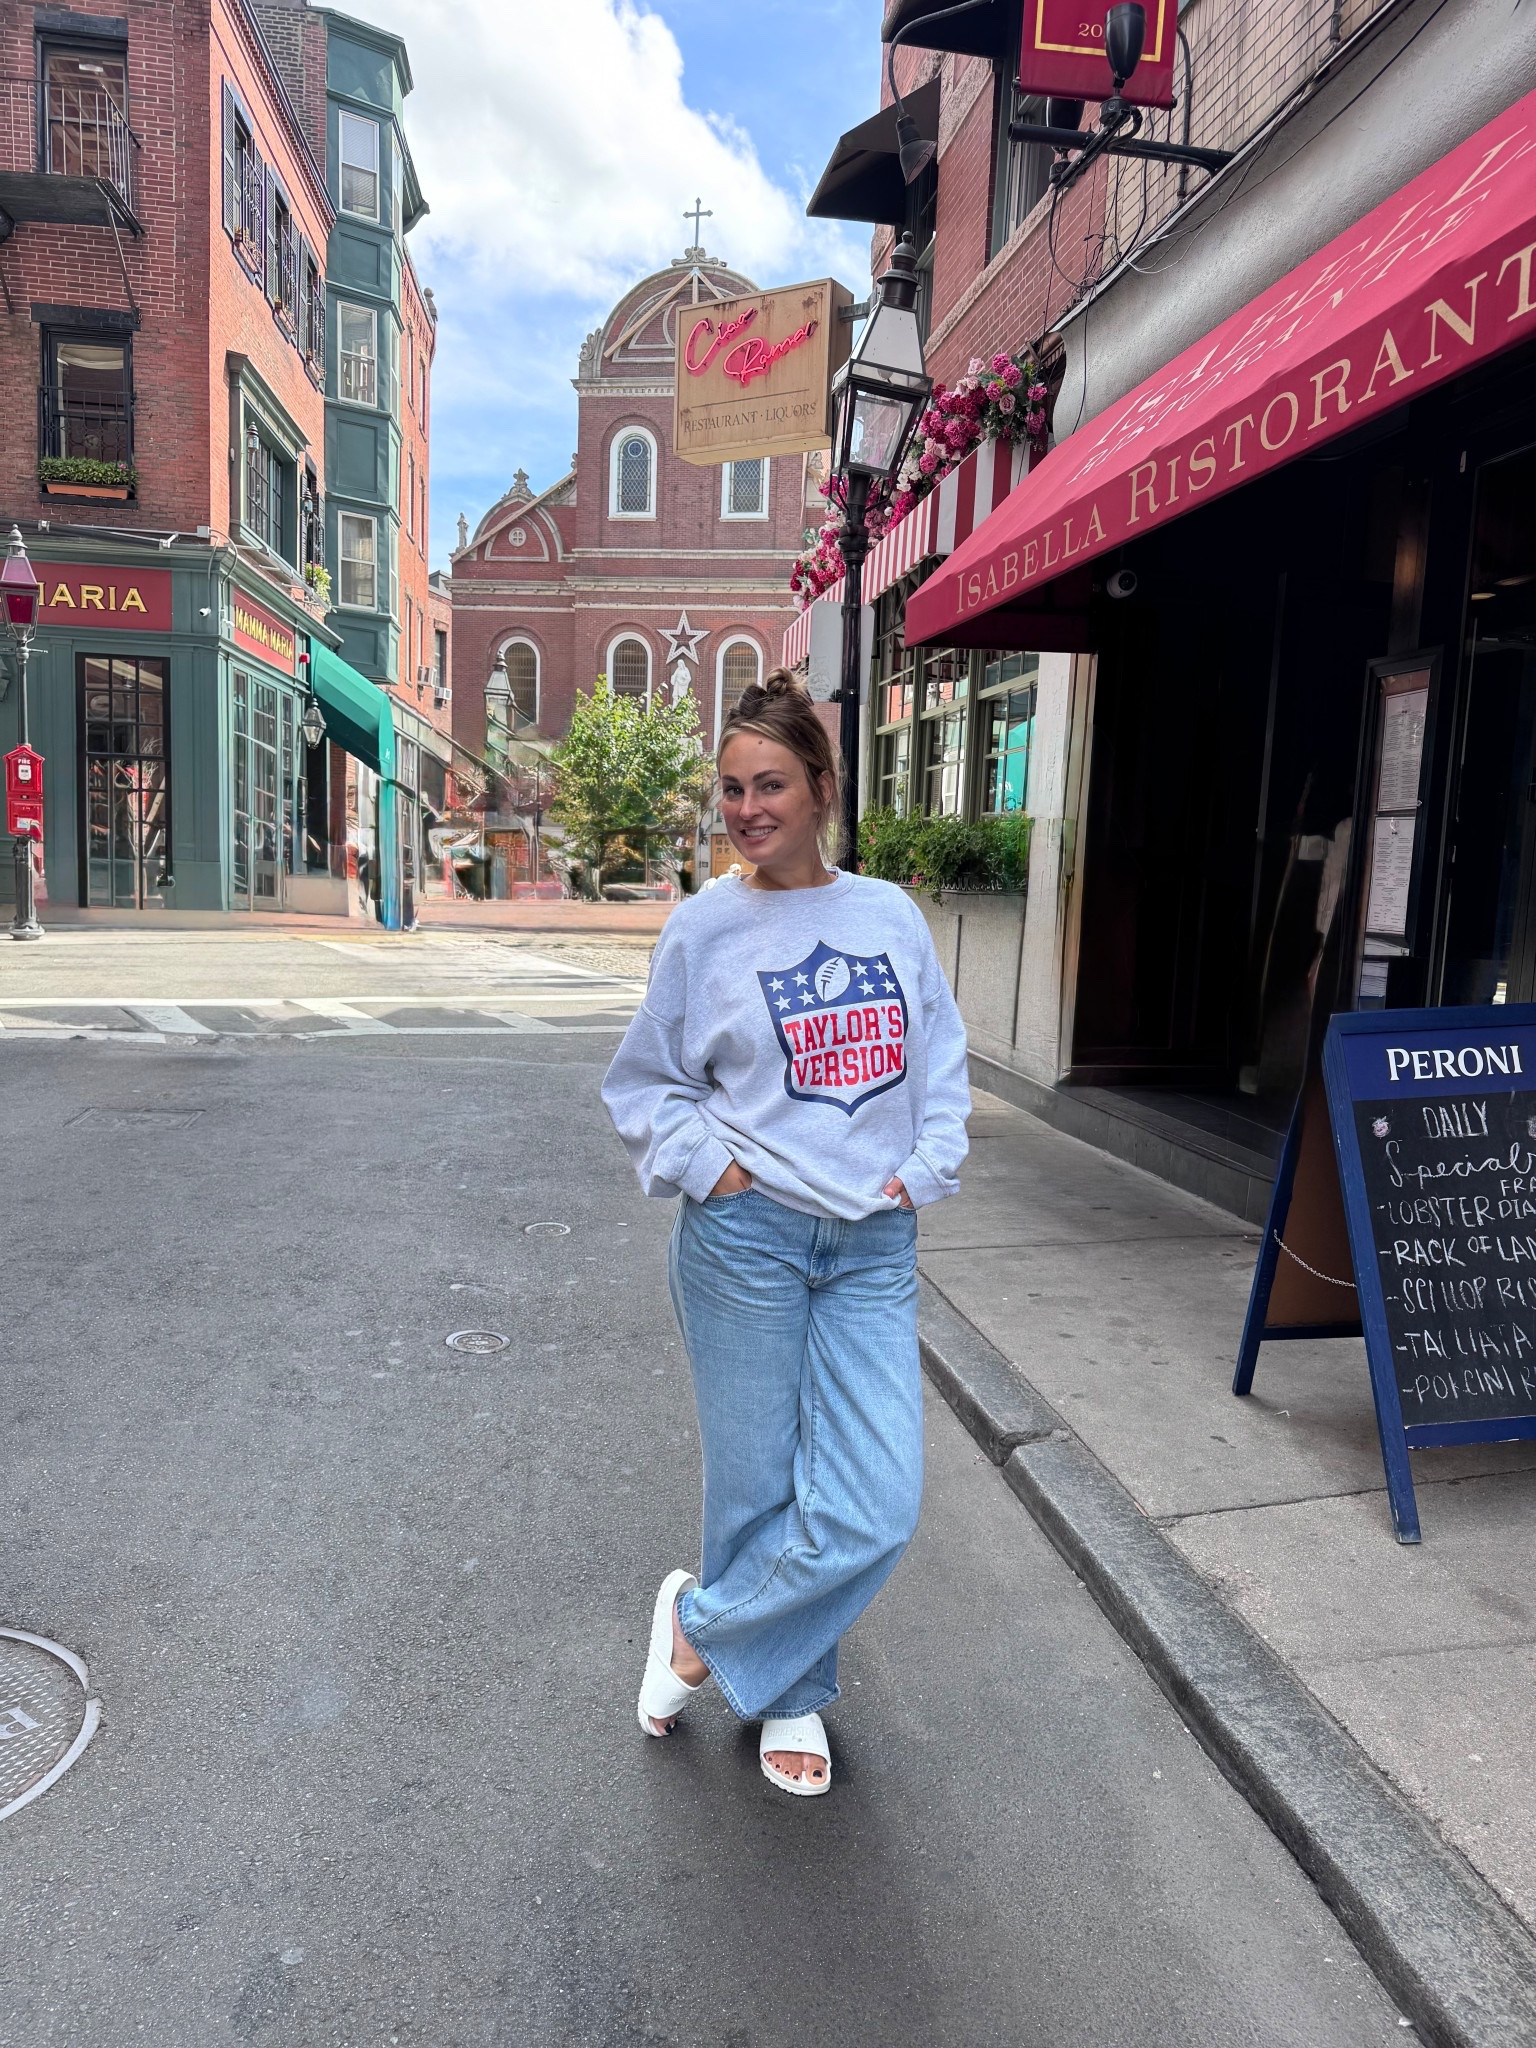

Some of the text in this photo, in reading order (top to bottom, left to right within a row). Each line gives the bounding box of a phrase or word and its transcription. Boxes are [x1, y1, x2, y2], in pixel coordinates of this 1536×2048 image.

[1088, 125, 1536, 453] ISABELL
[1066, 189, 1492, 486] RISTORANTE
[683, 402, 817, 433] RESTAURANT LIQUORS
[956, 503, 1107, 614] ISABELLA
[235, 605, 293, 662] MAMMA MARIA
[783, 1005, 903, 1055] TAYLOR'S
[792, 1043, 904, 1087] VERSION
[1386, 1045, 1523, 1081] PERONI
[1422, 1100, 1488, 1139] DAILY
[1467, 1236, 1492, 1254] OF
